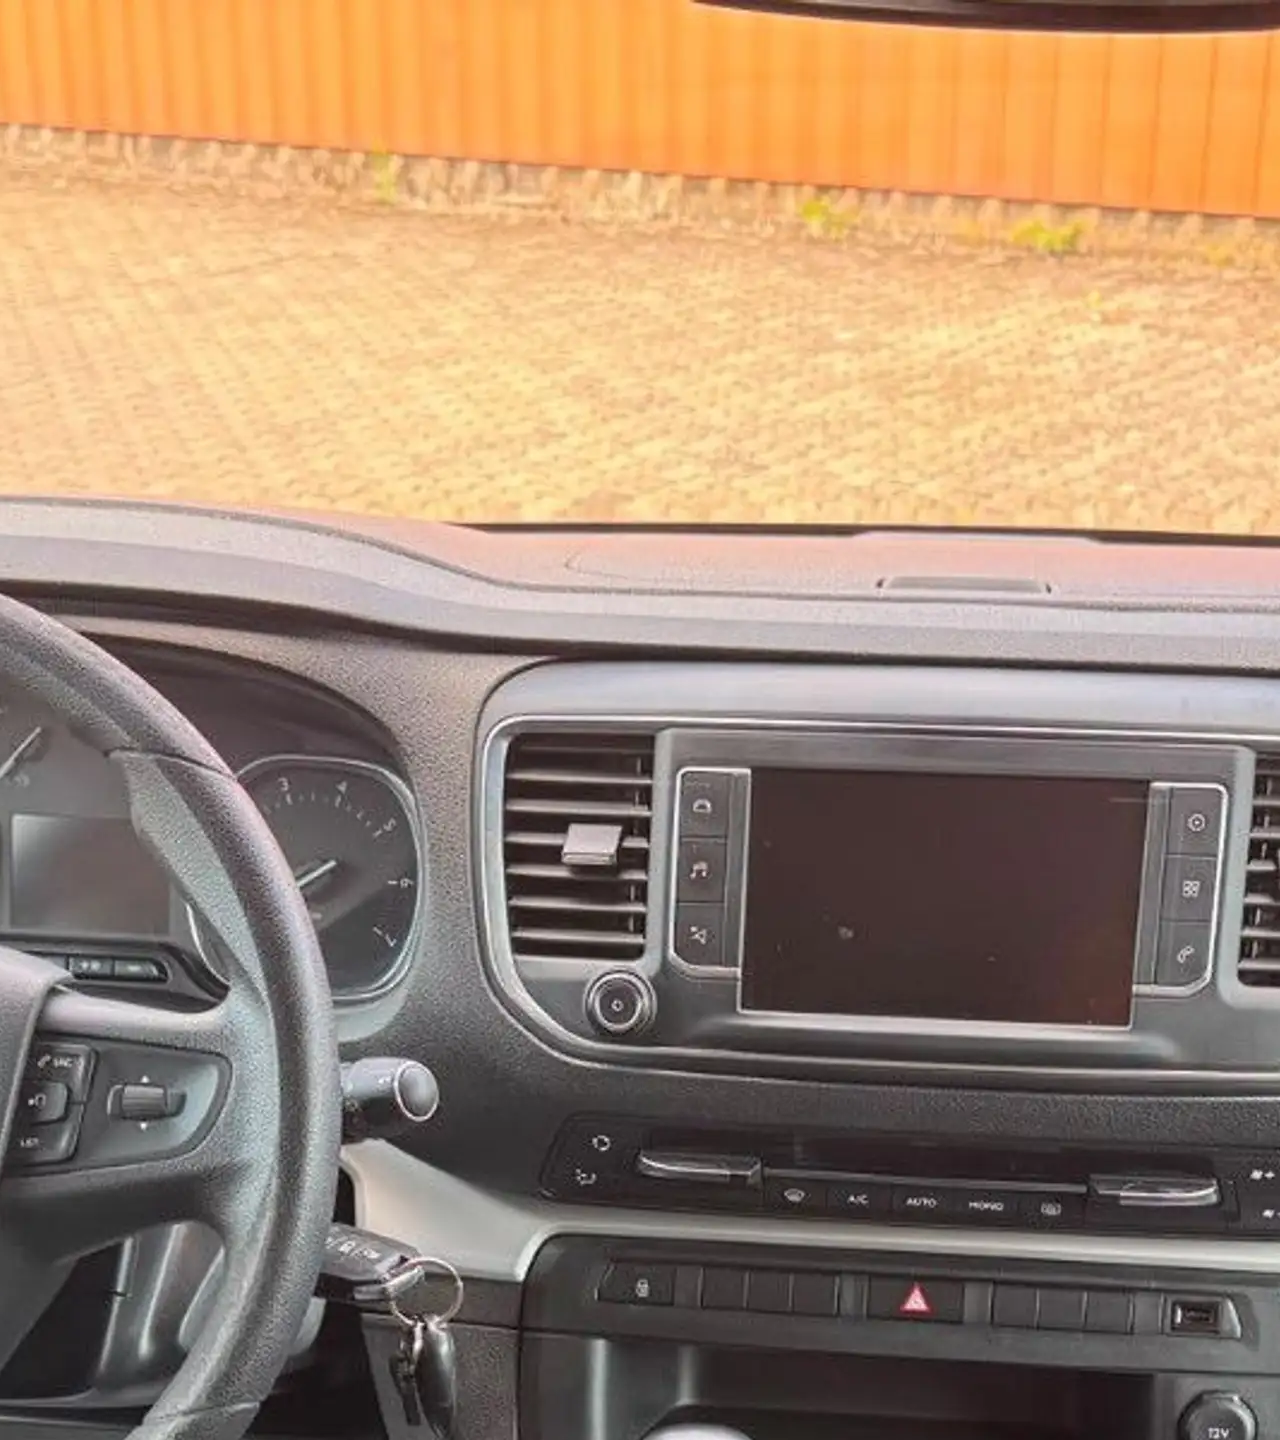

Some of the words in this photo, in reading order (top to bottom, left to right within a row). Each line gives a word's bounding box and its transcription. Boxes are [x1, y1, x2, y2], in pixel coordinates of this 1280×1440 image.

[277, 776, 290, 792] 3
[384, 933, 398, 948] 7
[847, 1194, 869, 1206] A/C
[906, 1196, 938, 1208] AUTO
[968, 1200, 1005, 1212] MONO
[1207, 1427, 1230, 1440] 12V
